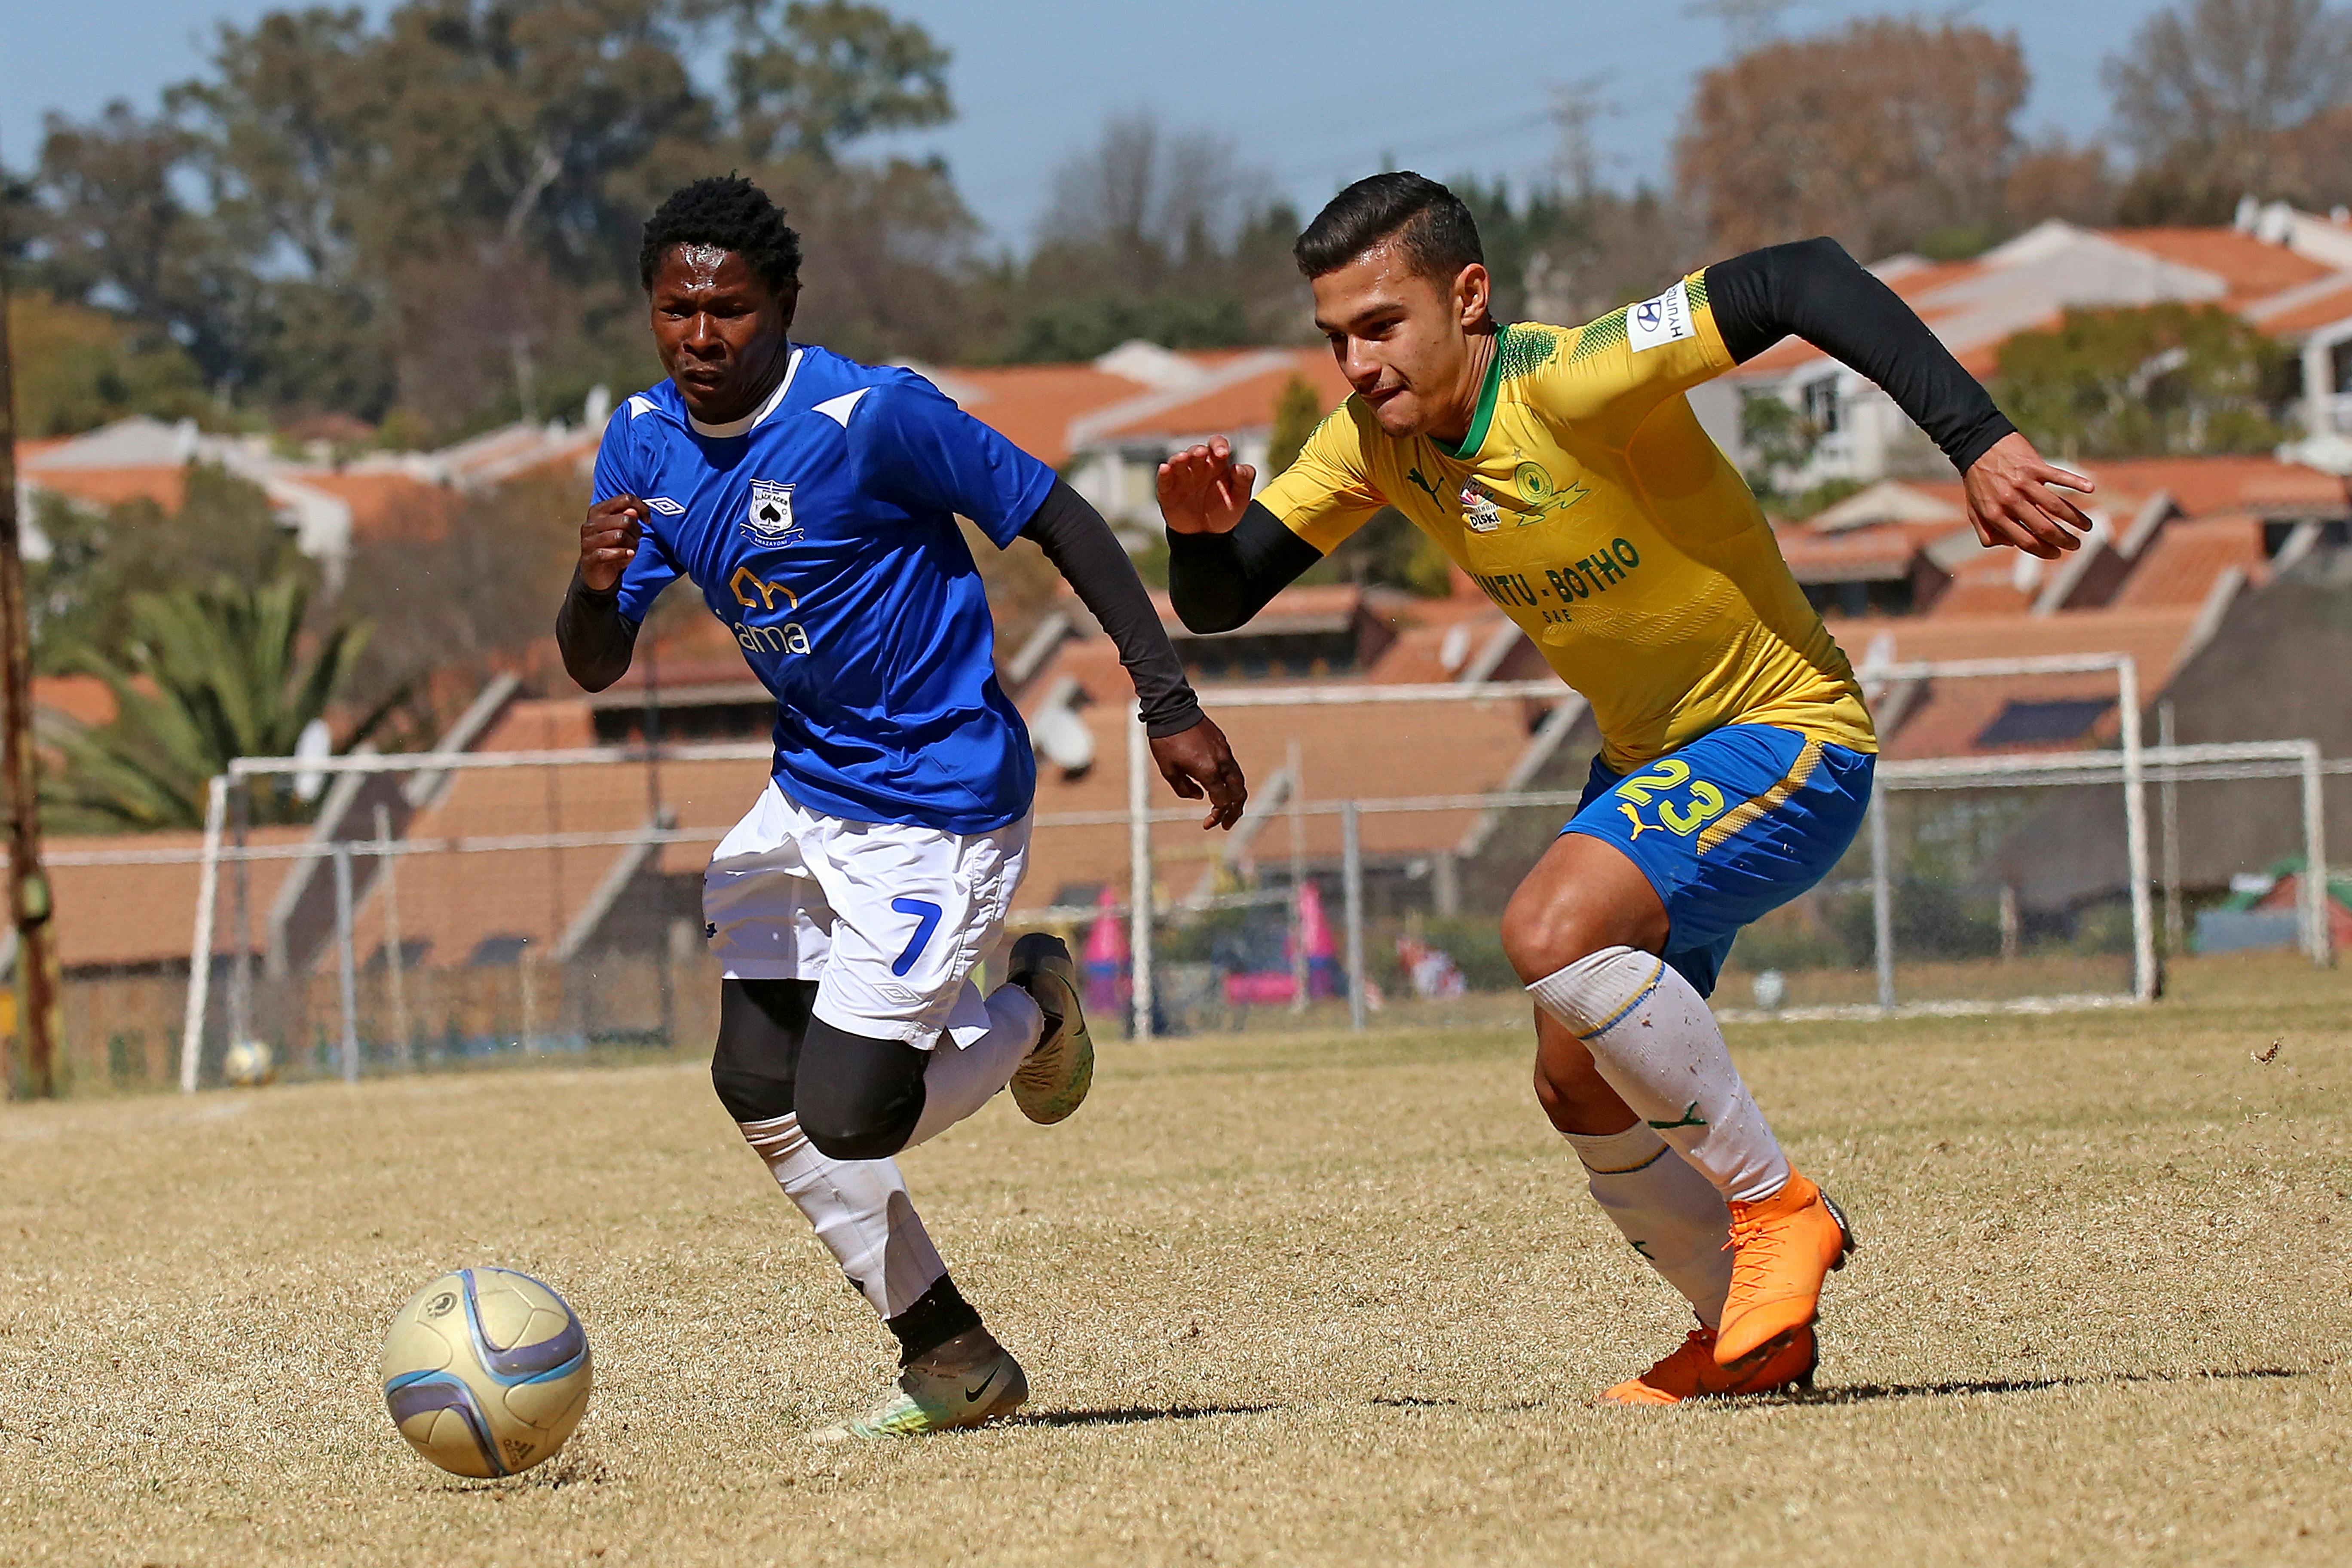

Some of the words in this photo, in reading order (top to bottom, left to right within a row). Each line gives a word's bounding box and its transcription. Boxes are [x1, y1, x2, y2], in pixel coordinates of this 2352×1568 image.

[1470, 512, 1500, 527] DISKI
[1545, 538, 1640, 603] BOTHO
[1615, 760, 1724, 836] 23
[892, 897, 942, 976] 7
